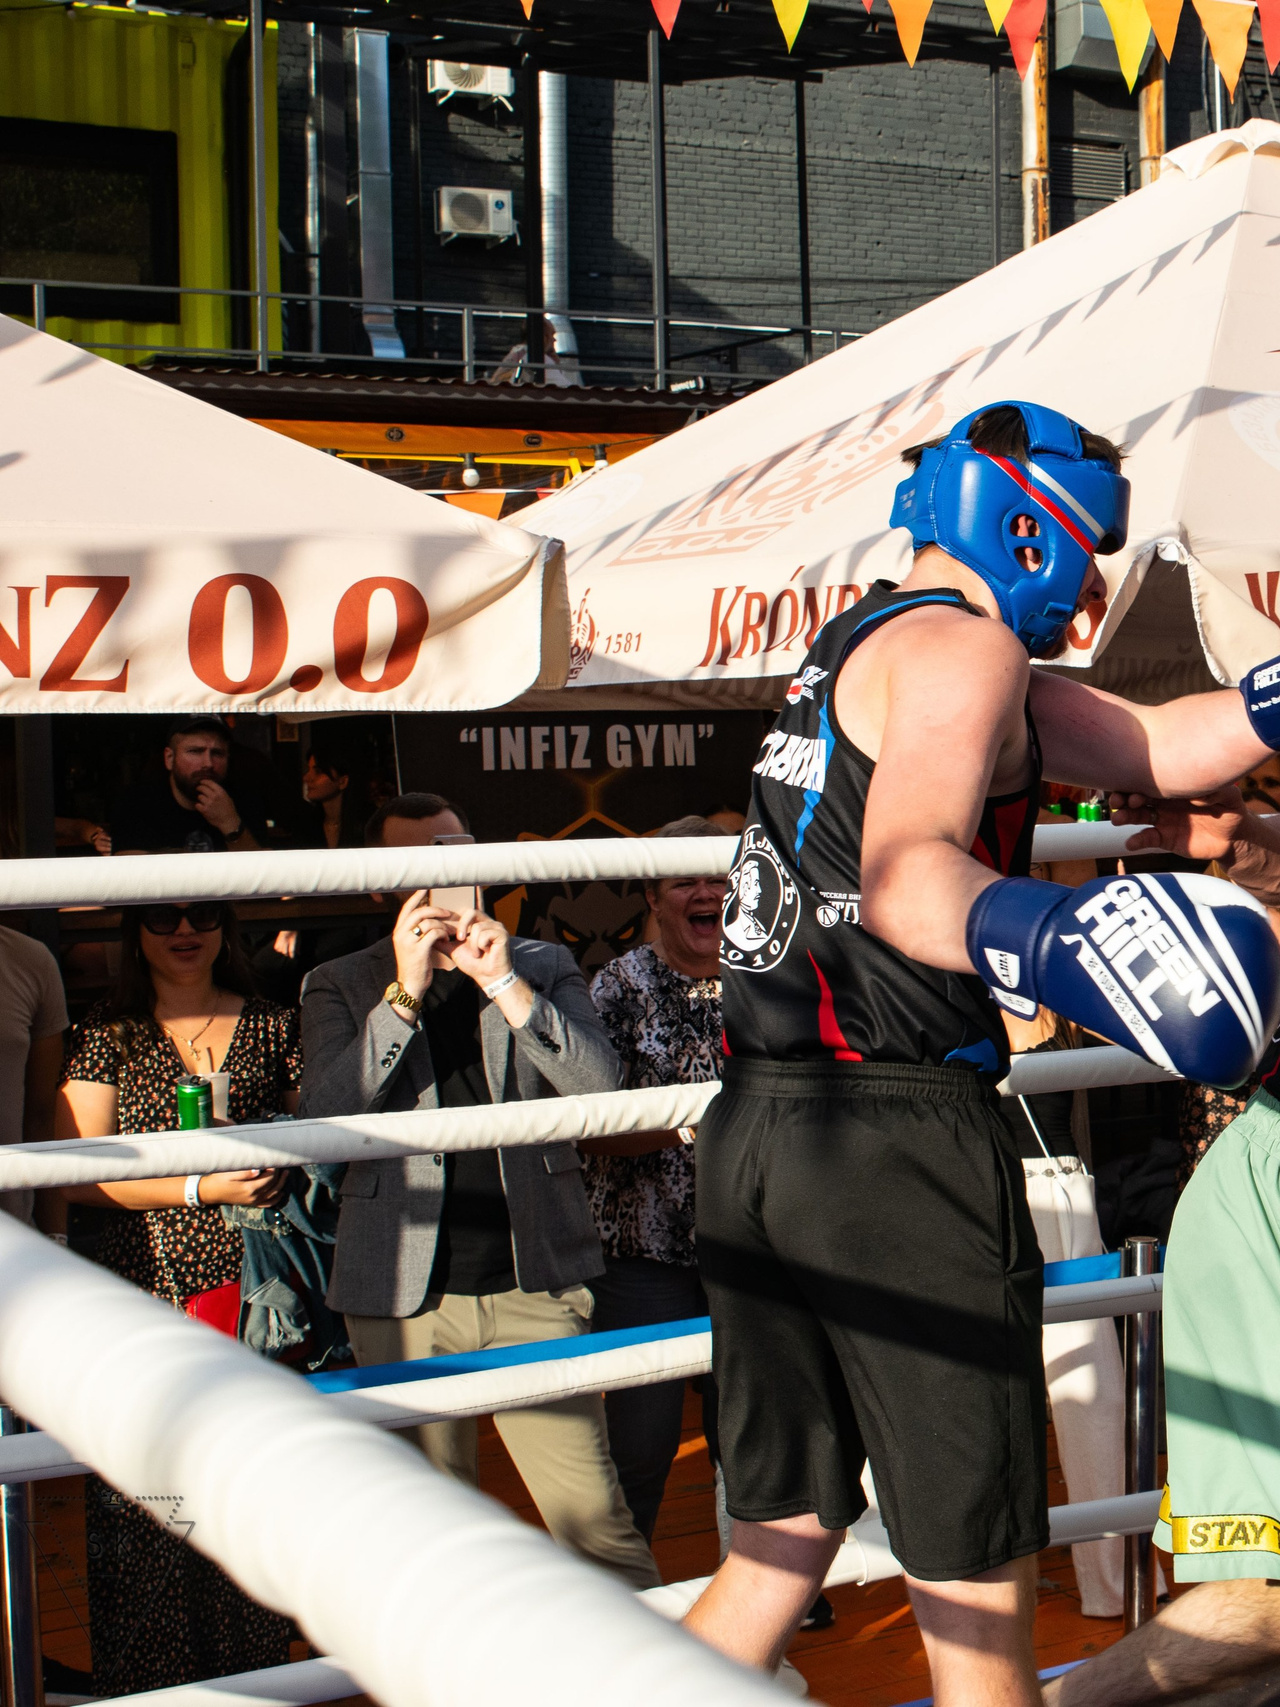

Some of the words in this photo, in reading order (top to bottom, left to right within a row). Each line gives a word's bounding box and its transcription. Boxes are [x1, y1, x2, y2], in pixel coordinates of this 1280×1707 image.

[187, 573, 429, 694] 0.0
[604, 631, 642, 654] 1581
[1254, 672, 1280, 691] HILL
[1074, 892, 1163, 1022] HILL
[1105, 879, 1222, 1017] GREEN
[1188, 1521, 1267, 1548] STAY
